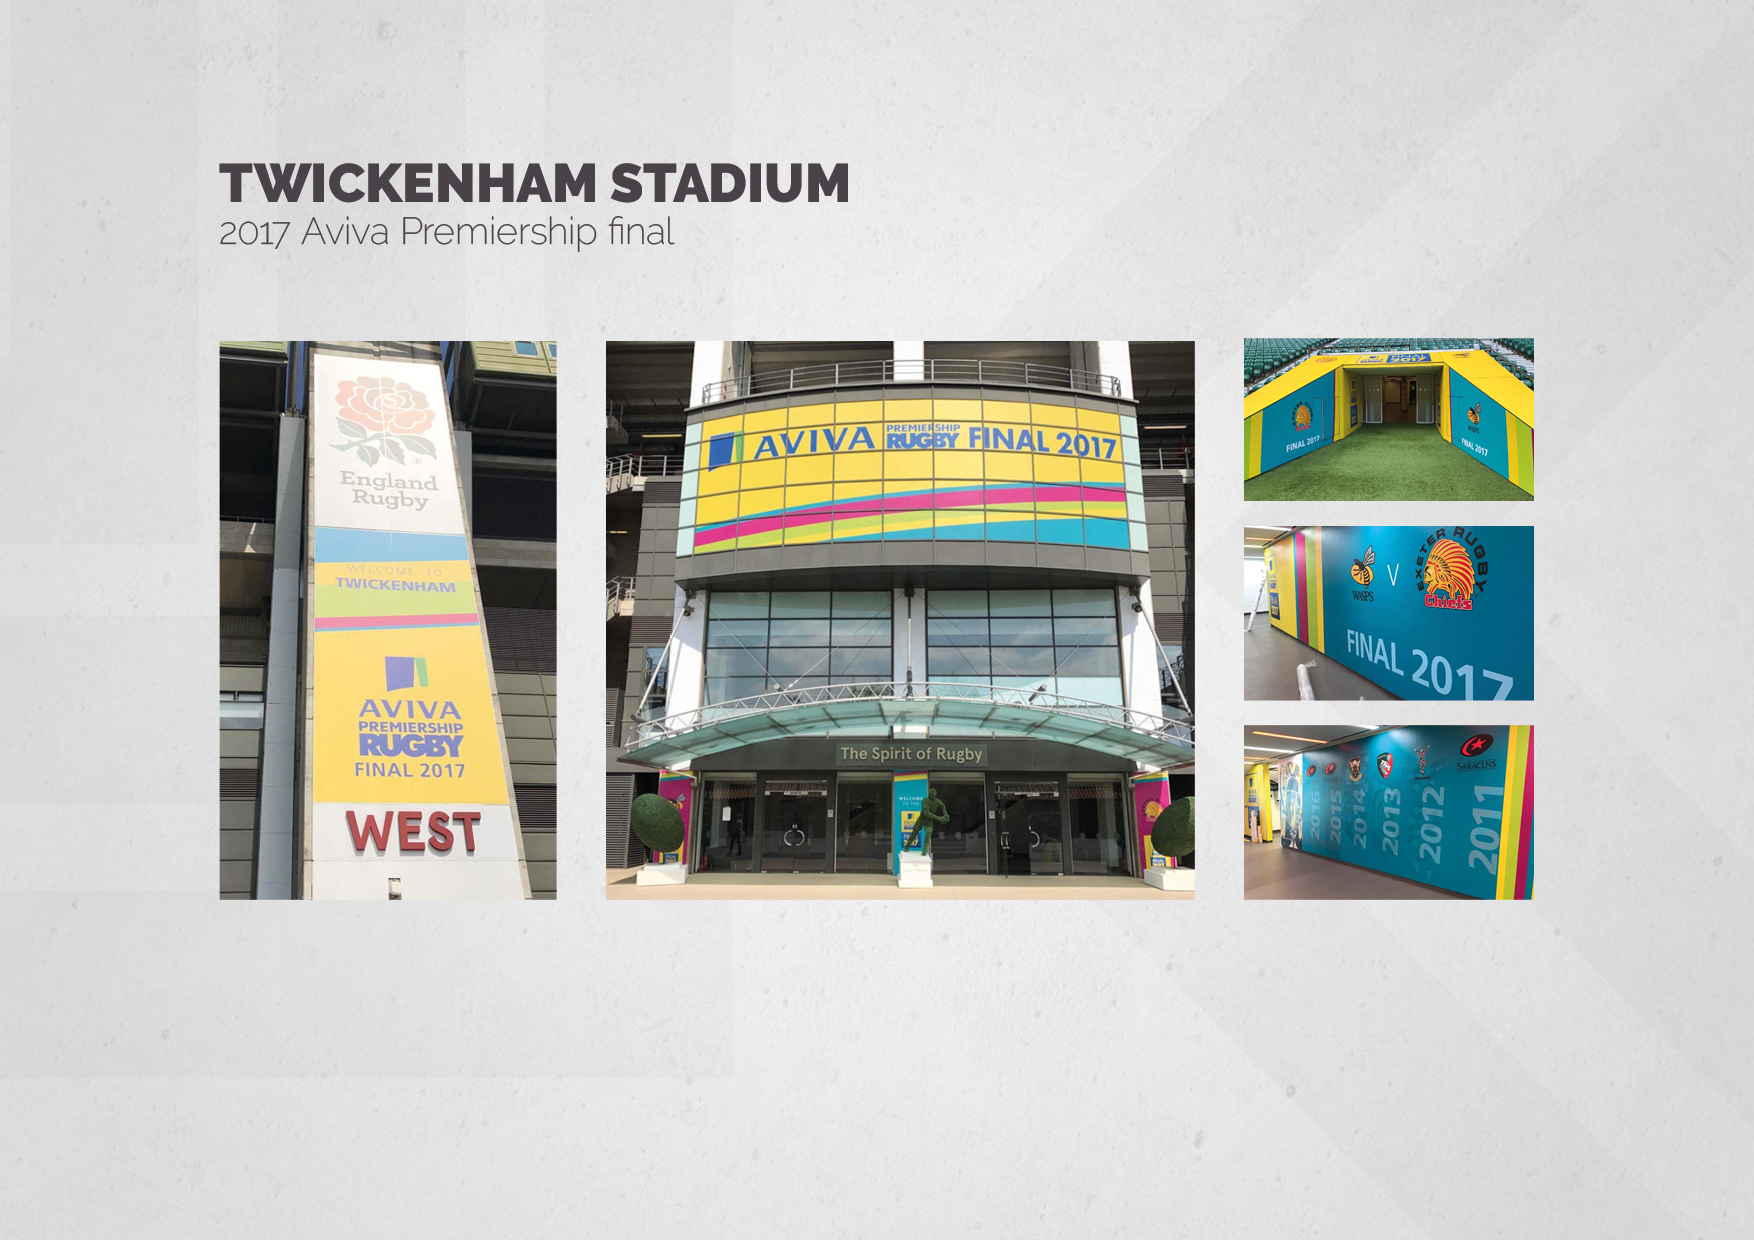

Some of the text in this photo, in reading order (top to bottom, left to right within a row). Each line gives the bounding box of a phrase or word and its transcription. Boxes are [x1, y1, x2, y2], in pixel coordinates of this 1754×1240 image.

[886, 424, 961, 433] PREMIERSHIP
[754, 426, 876, 460] AVIVA
[886, 426, 1117, 460] RUGBY FINAL 2017
[1286, 435, 1320, 452] FINAL 2017
[1461, 437, 1488, 457] FINAL 2017
[340, 470, 439, 491] England
[352, 489, 429, 511] Rugby
[347, 564, 442, 577] WELCOME TO
[1415, 526, 1488, 594] EXETER RUGBY
[335, 577, 456, 593] TWICKENHAM
[1351, 590, 1374, 602] WASPS
[1424, 593, 1473, 611] Chiefs
[1347, 629, 1514, 701] FINAL 2017
[359, 699, 462, 720] AVIVA
[358, 721, 464, 734] PREMIERSHIP
[359, 733, 464, 758] RUGBY
[840, 746, 983, 764] The Spirit of Rugby
[355, 762, 465, 778] FINAL 2017
[1456, 760, 1497, 771] SARACENS
[1310, 790, 1321, 840] 2016
[1330, 790, 1342, 845] 2015
[1353, 790, 1367, 850] 2014
[1382, 787, 1401, 856] 2013
[1419, 785, 1445, 865] 2012
[345, 810, 481, 853] WEST
[1468, 785, 1504, 876] 2011
